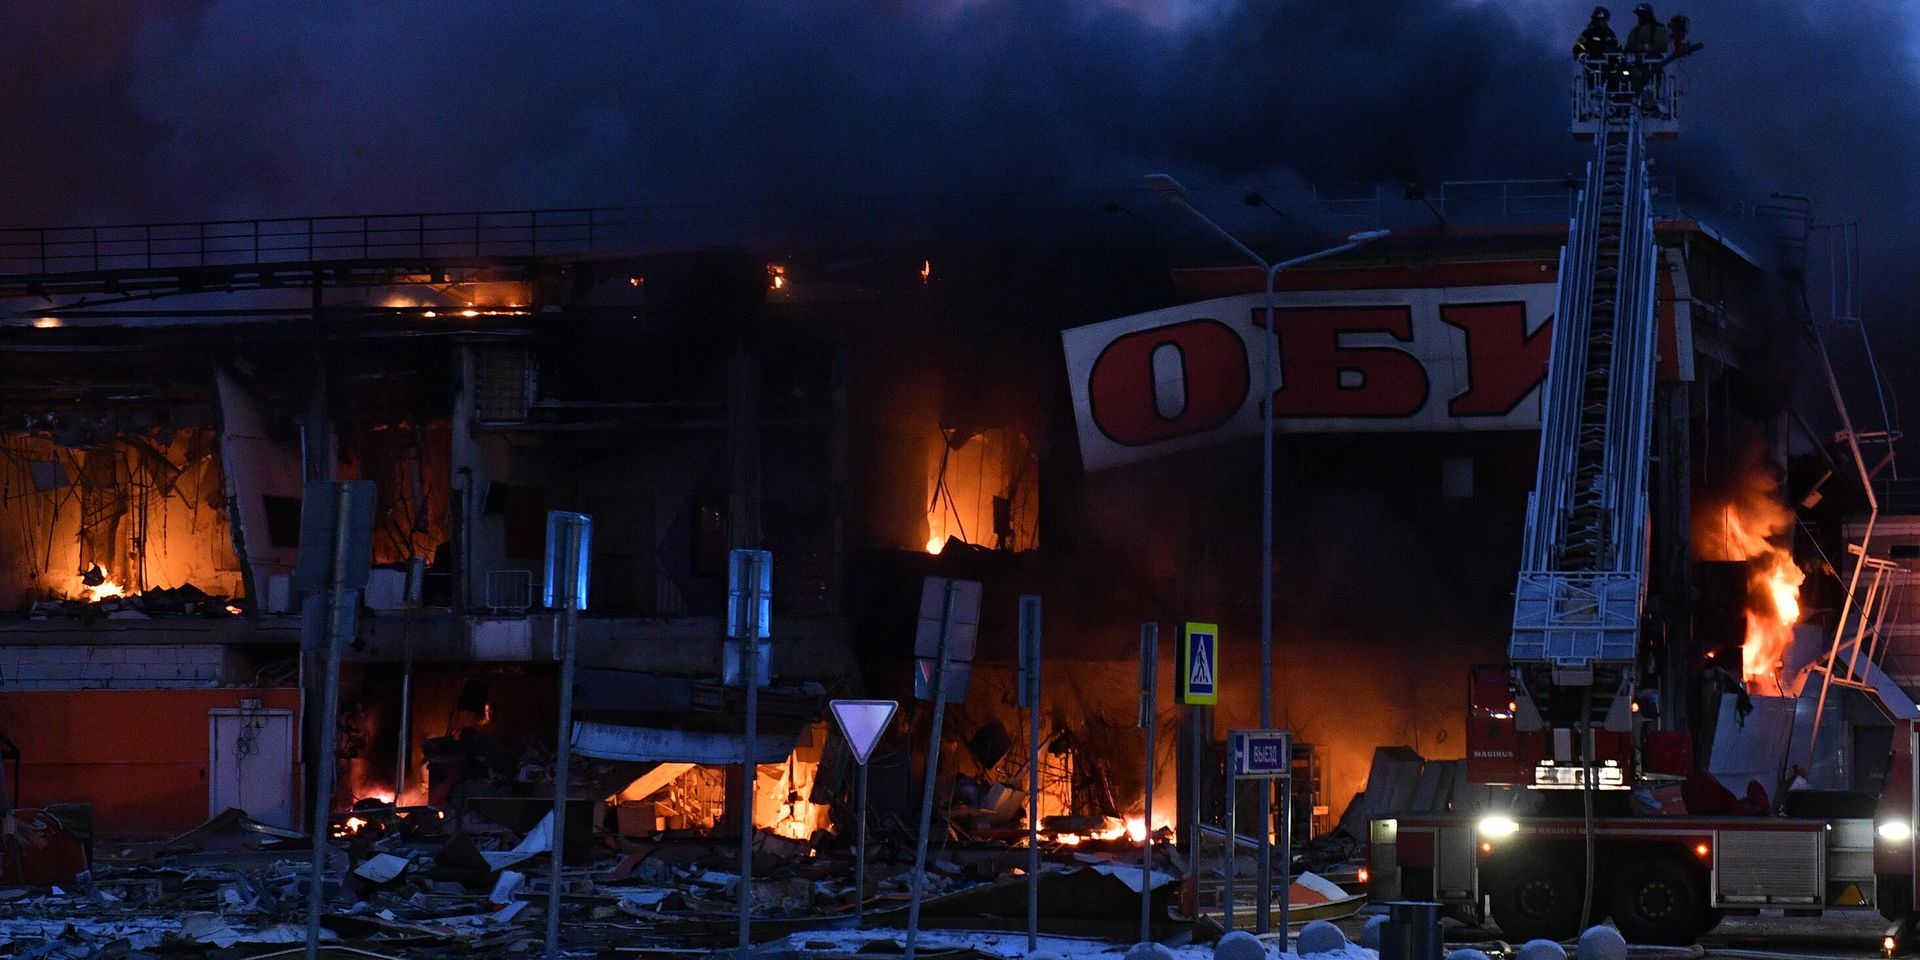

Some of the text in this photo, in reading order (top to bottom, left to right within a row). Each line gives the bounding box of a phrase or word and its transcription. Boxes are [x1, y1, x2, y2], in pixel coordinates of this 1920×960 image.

[1088, 300, 1555, 447] ОБИ
[1253, 745, 1277, 765] ВЫЕЗД
[1473, 750, 1514, 758] MAGIRUS
